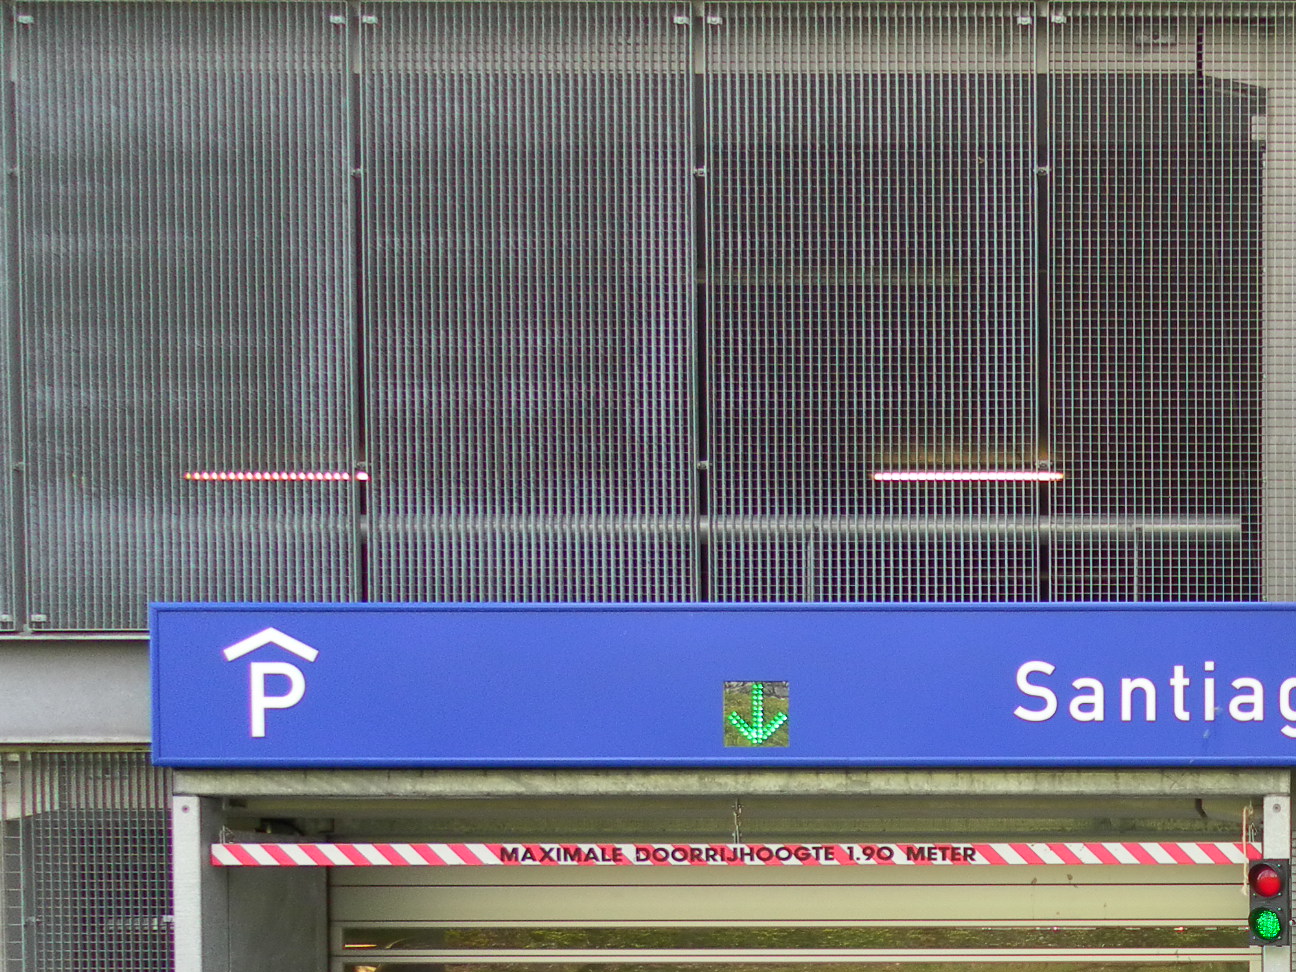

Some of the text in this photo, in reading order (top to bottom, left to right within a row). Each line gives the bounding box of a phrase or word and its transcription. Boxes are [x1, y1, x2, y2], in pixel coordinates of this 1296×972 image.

[250, 661, 306, 738] P
[500, 846, 977, 863] MAXIMALE DOORRIJHOOGTE 1.90 METER
